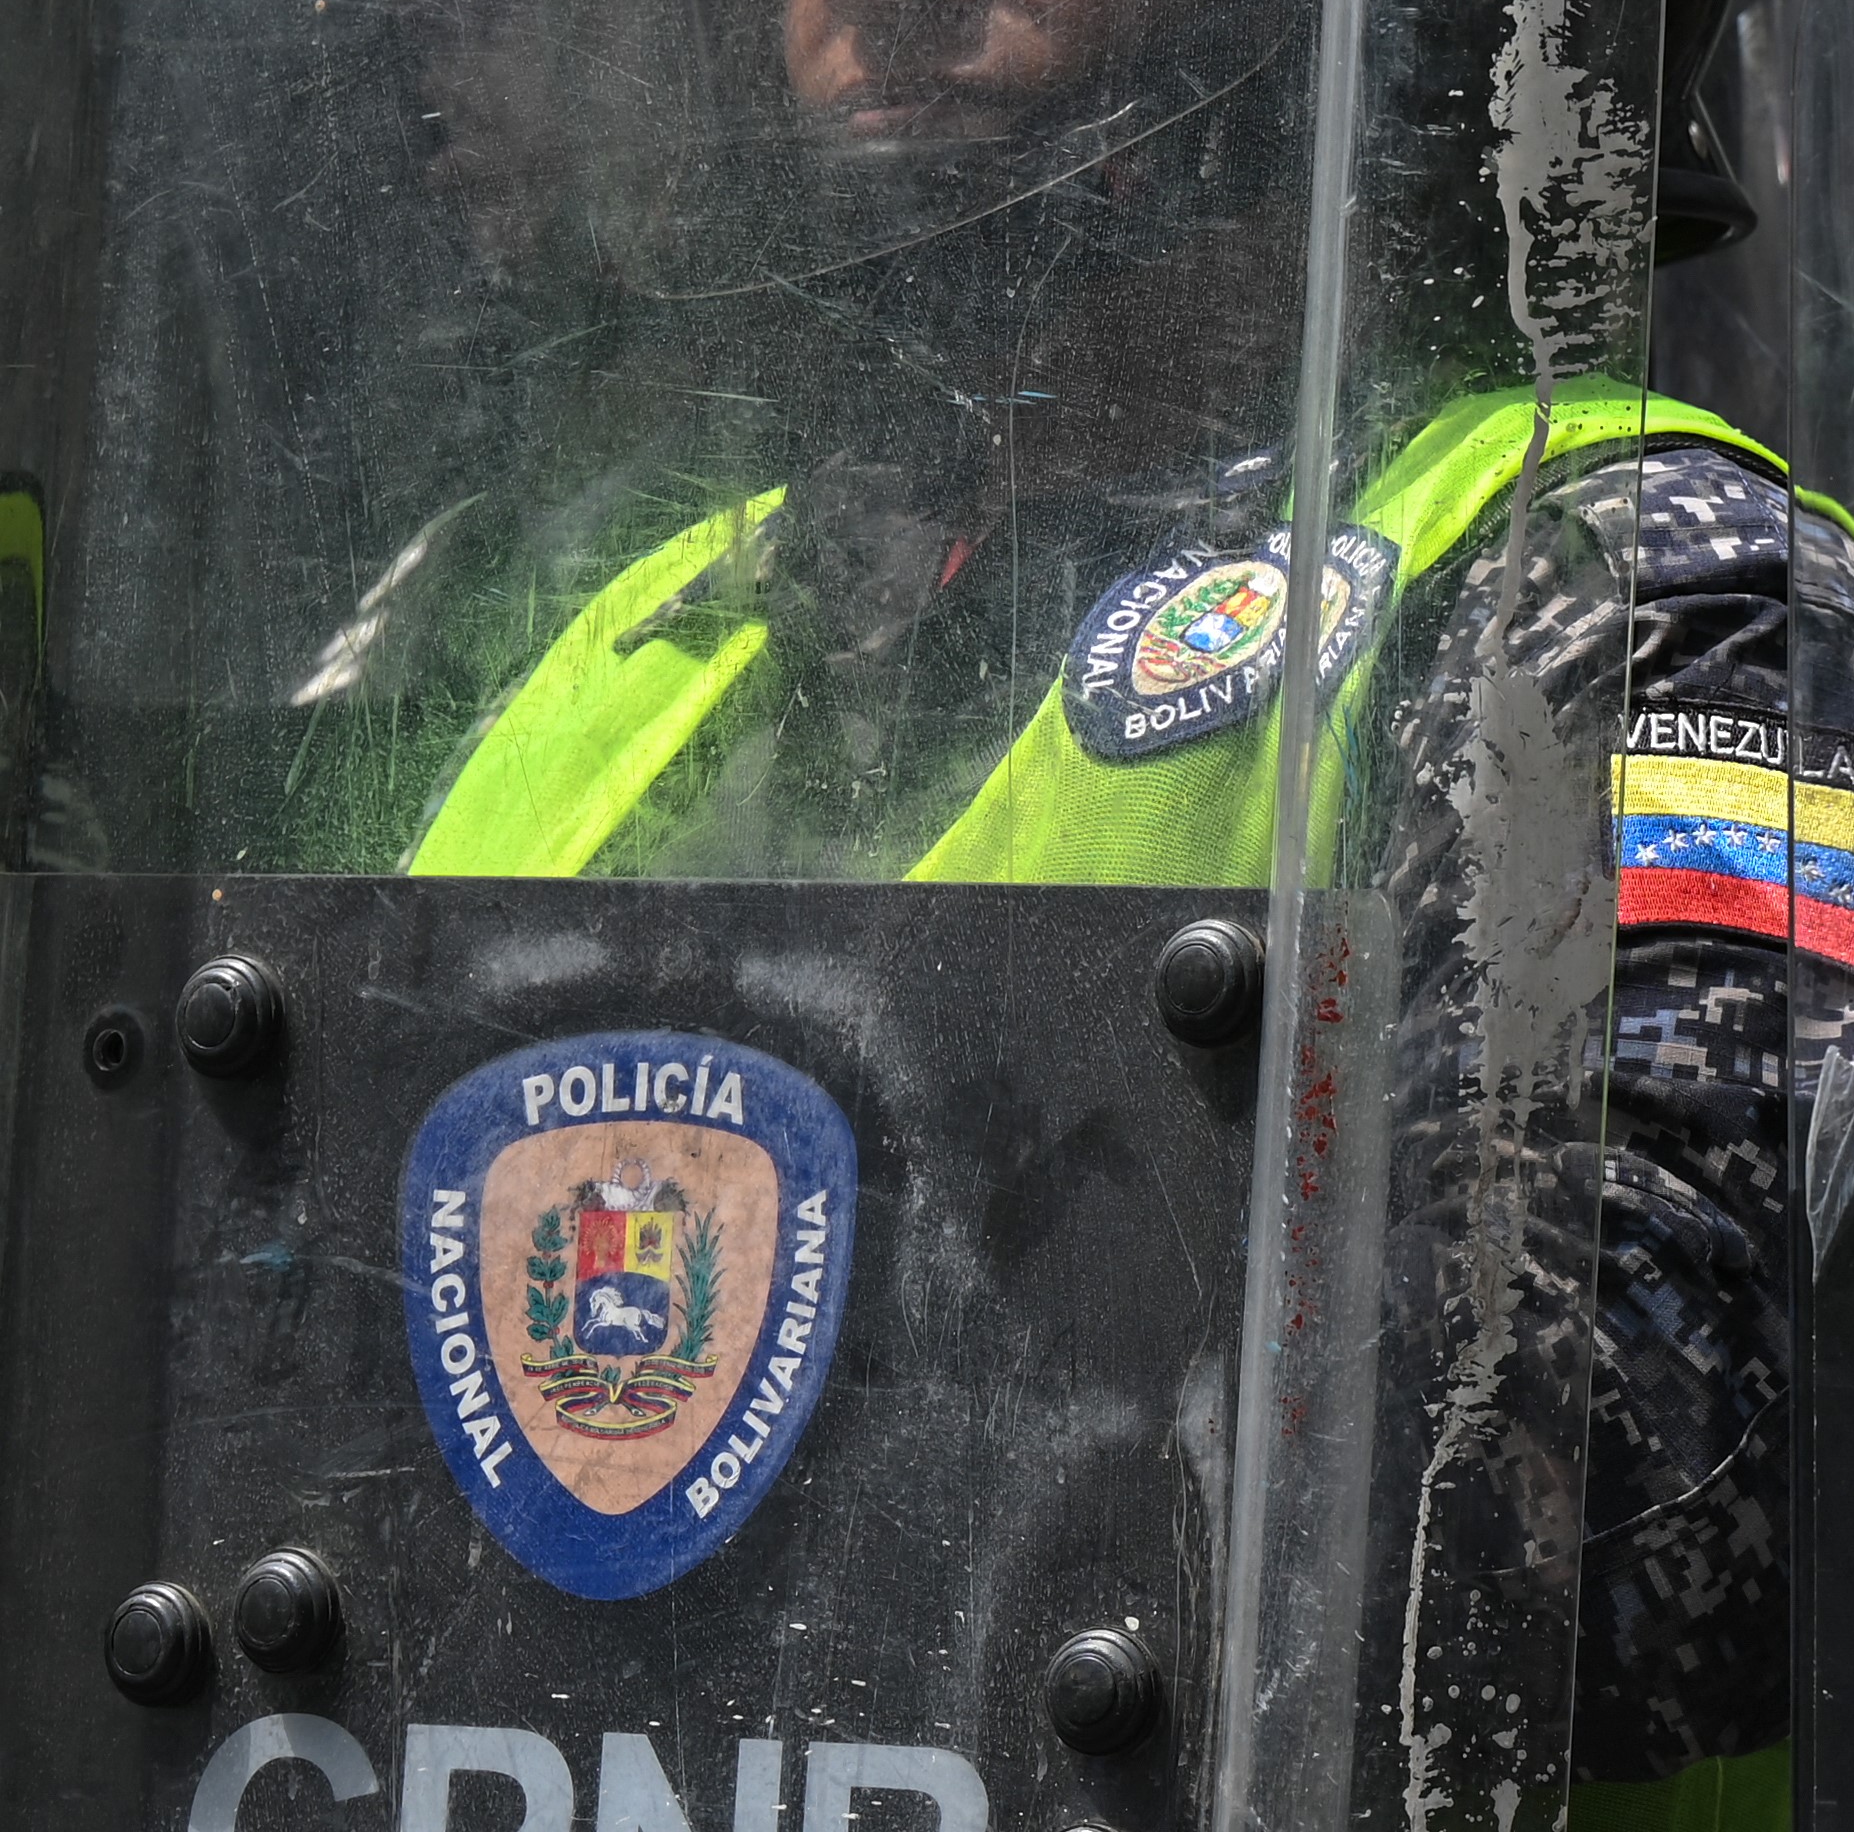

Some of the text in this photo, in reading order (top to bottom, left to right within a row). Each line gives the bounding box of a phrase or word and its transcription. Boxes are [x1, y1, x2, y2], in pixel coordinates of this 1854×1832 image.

[1082, 540, 1216, 700] NACIONAL
[521, 1054, 745, 1126] POLICÍA
[428, 1188, 513, 1488] NACIONAL
[684, 1189, 829, 1519] BOLIVARIANA
